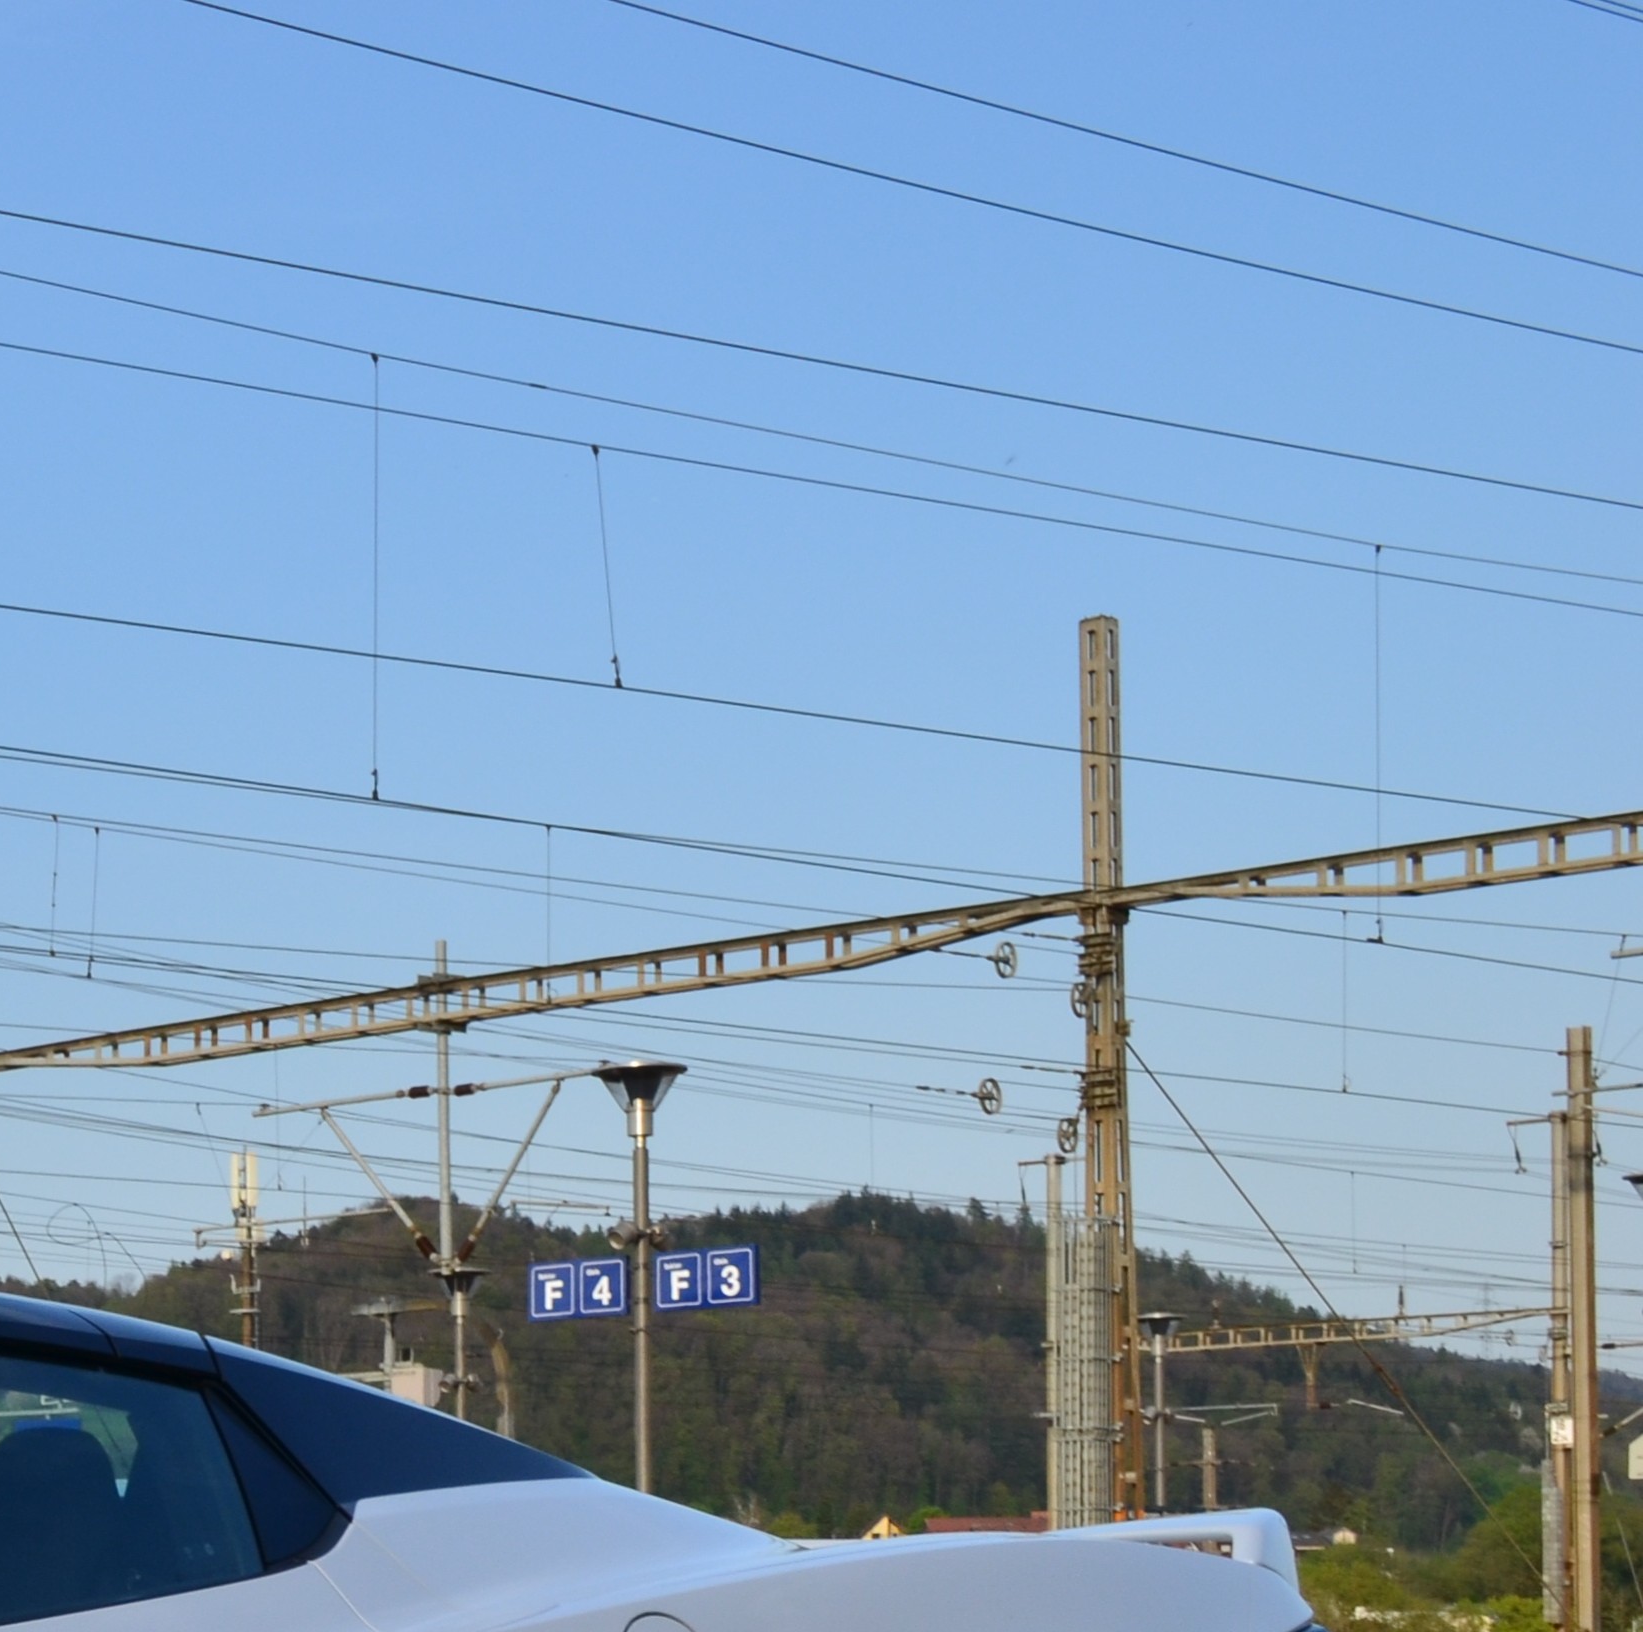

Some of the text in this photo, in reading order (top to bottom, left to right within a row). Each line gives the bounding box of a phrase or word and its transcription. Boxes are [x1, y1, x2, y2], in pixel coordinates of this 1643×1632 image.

[545, 1275, 612, 1311] F 4
[670, 1265, 741, 1301] F 3
